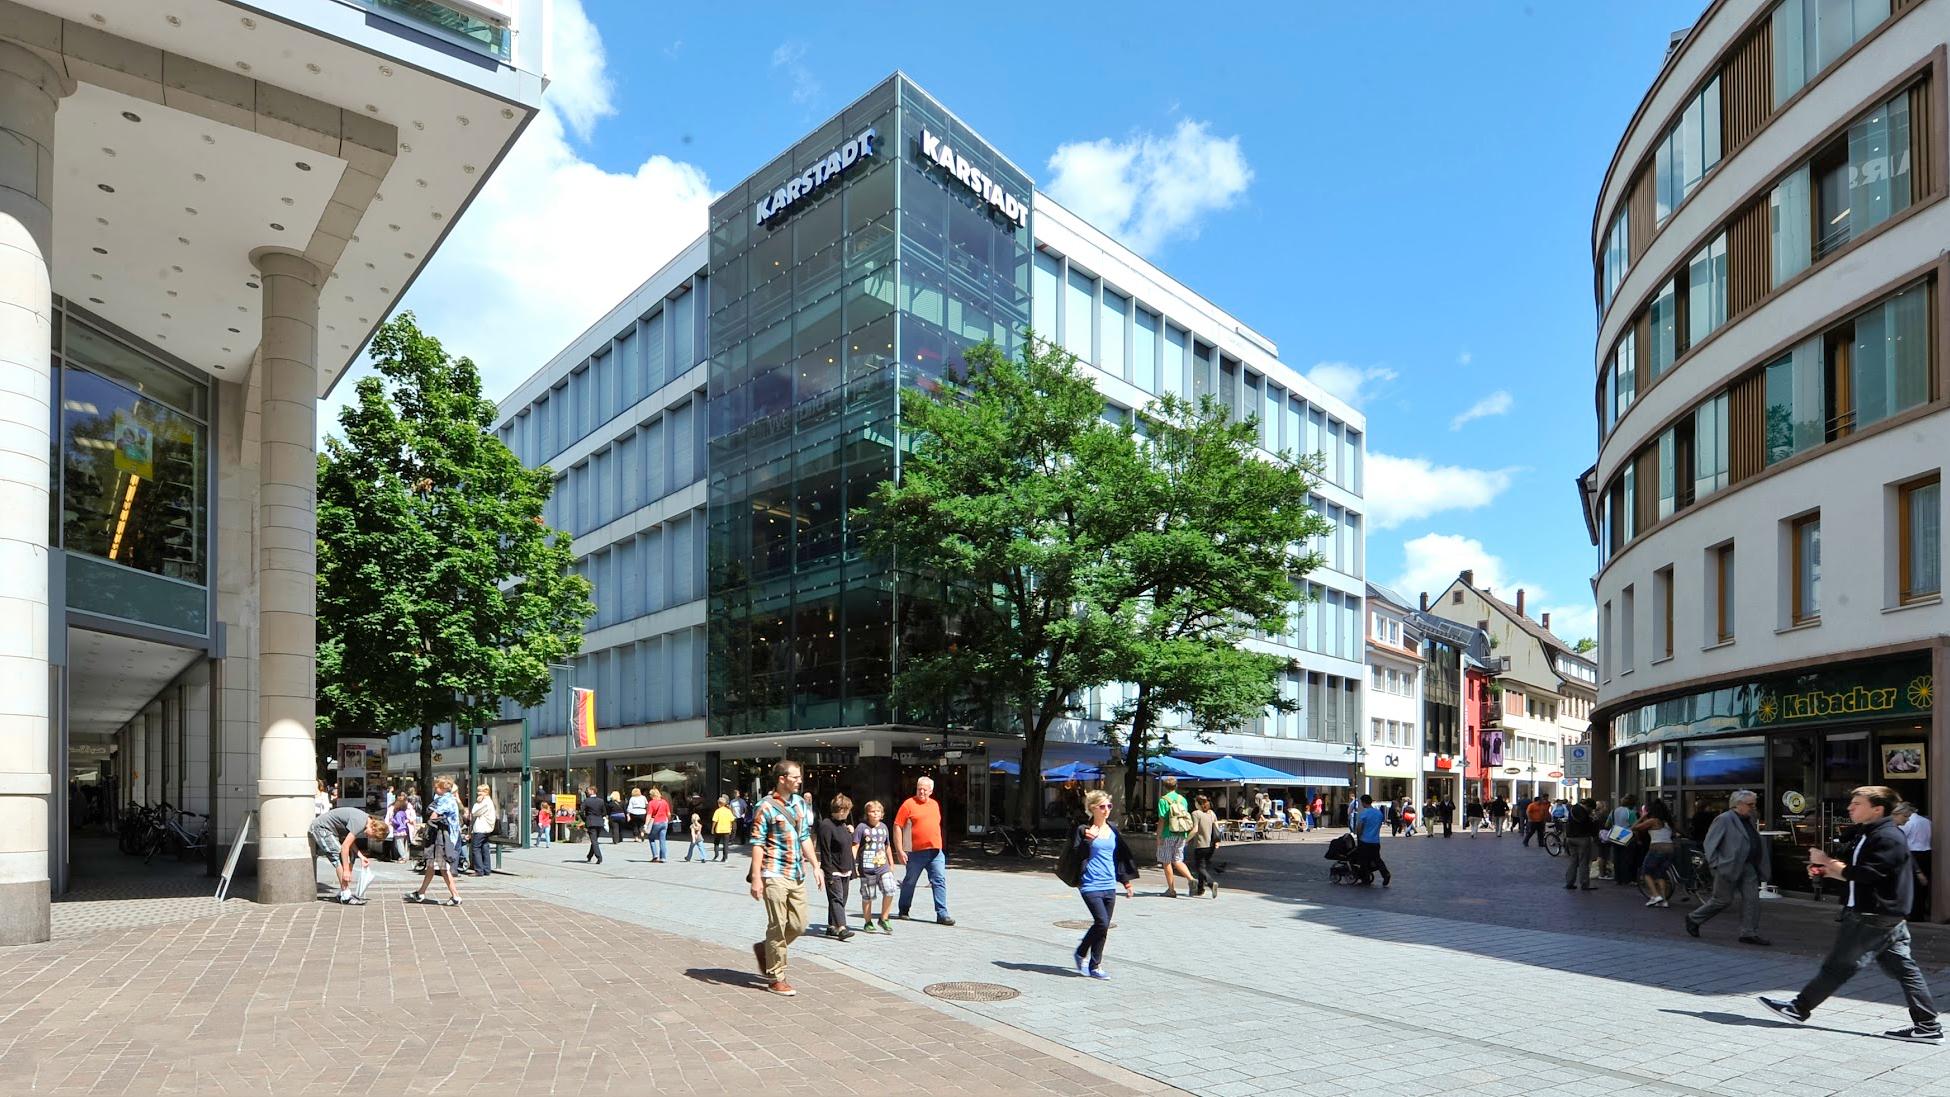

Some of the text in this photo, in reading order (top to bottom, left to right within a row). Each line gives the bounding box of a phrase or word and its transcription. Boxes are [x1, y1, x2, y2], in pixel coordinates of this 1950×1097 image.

[756, 128, 876, 225] KARSTADT
[921, 128, 1029, 228] KARSTADT
[1783, 686, 1897, 719] Kalbacher
